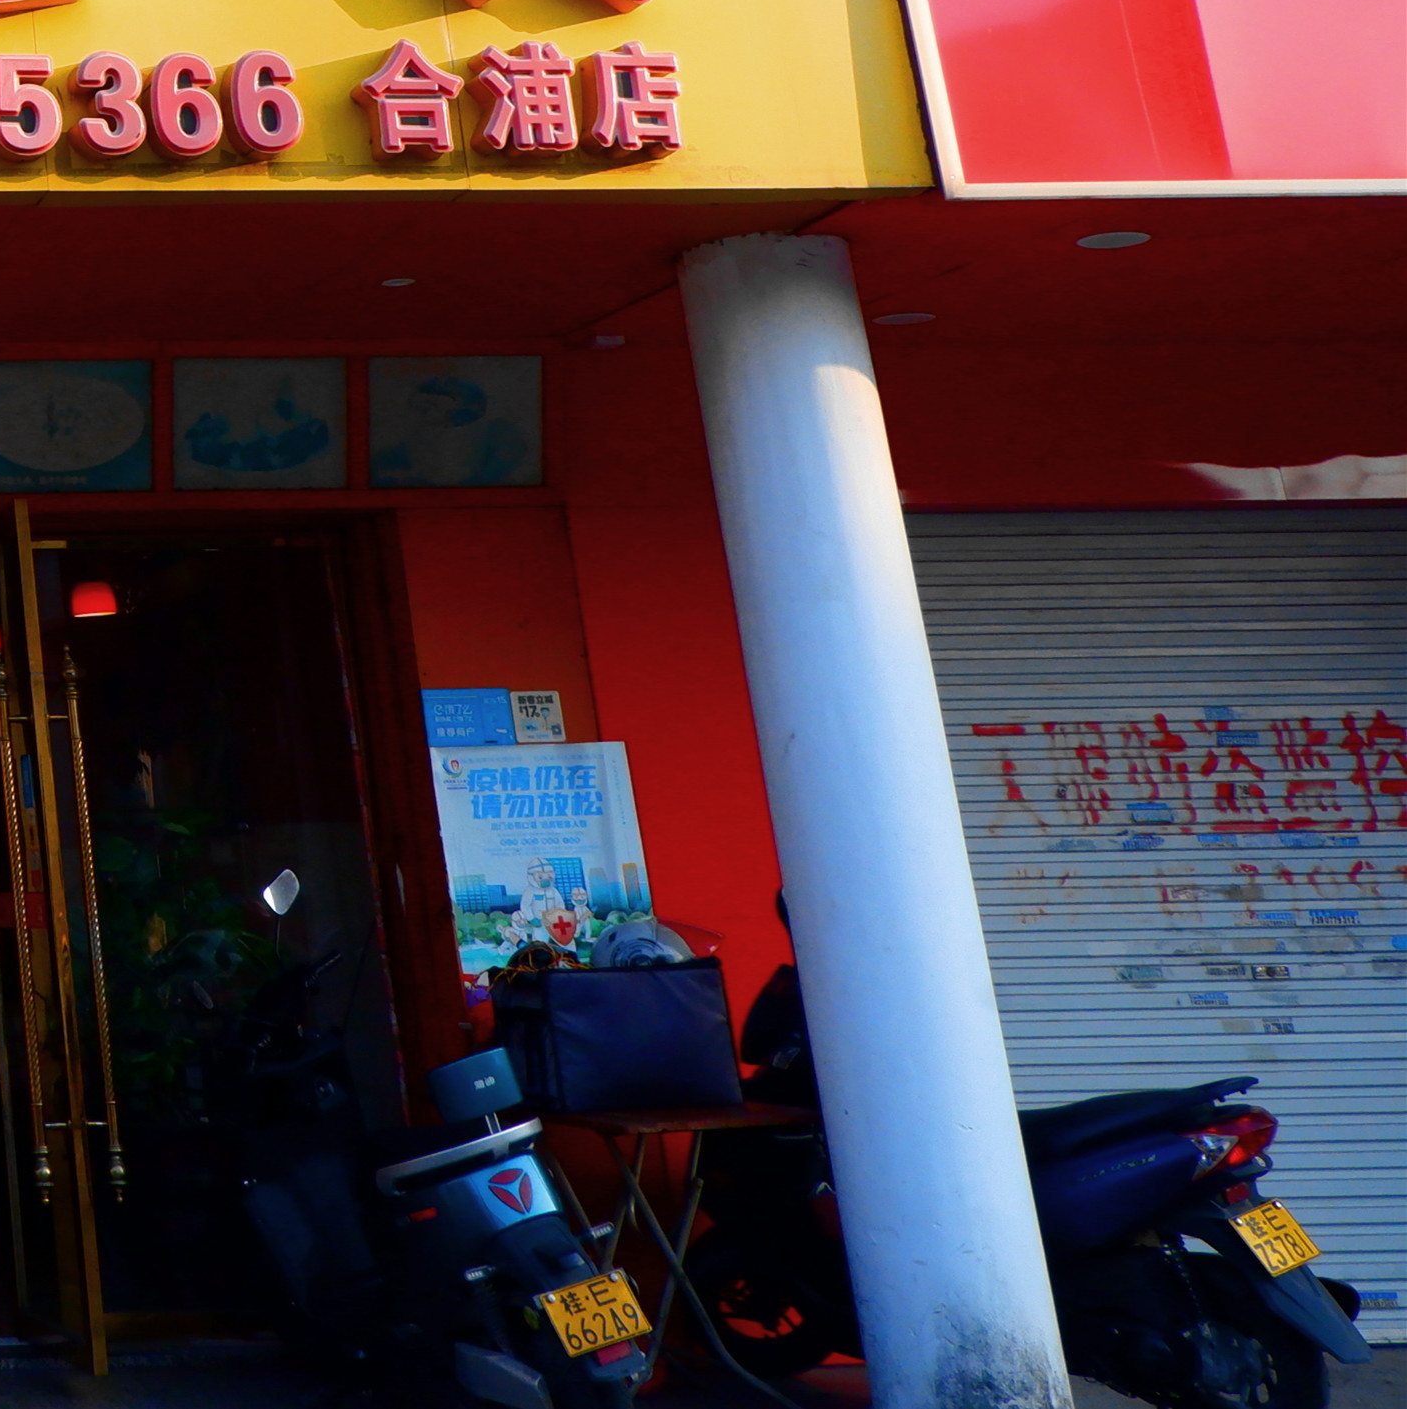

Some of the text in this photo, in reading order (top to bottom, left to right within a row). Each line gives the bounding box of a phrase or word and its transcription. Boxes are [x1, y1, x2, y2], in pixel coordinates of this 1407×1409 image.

[352, 38, 683, 163] 合浦店
[466, 765, 597, 792] 疫情仍在
[471, 791, 604, 819] 请勿放松
[565, 1302, 640, 1350] 662A9
